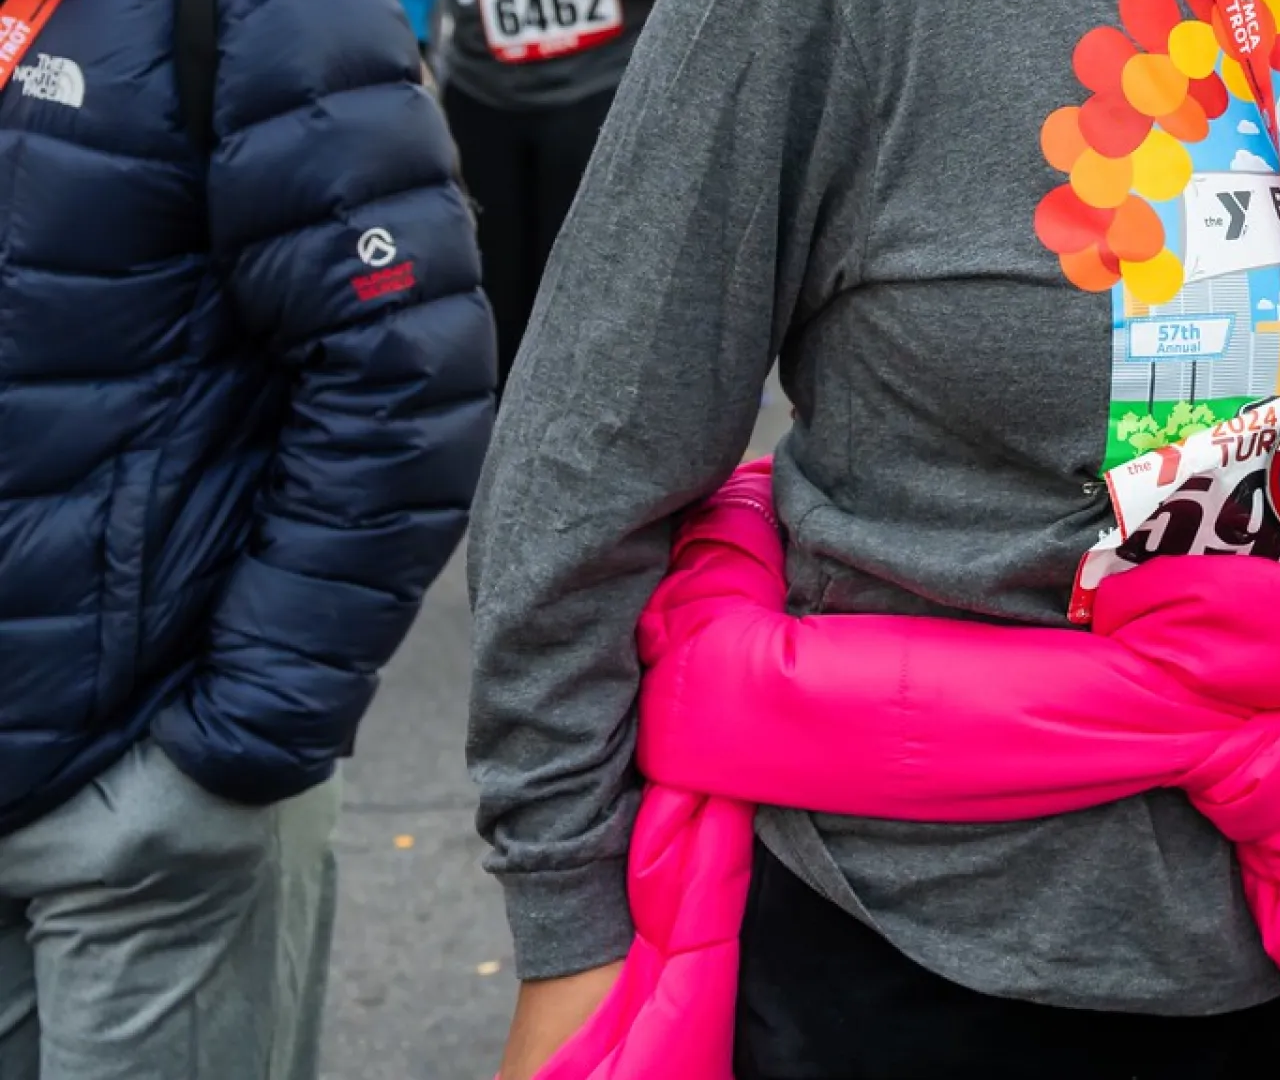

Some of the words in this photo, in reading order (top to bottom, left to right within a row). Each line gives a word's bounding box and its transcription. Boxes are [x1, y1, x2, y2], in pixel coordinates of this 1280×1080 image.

[1226, 0, 1251, 54] TROT
[1204, 216, 1223, 227] the
[1158, 323, 1201, 341] 57th
[1157, 341, 1201, 354] Annual
[1211, 406, 1277, 438] 2024
[1127, 461, 1152, 475] the
